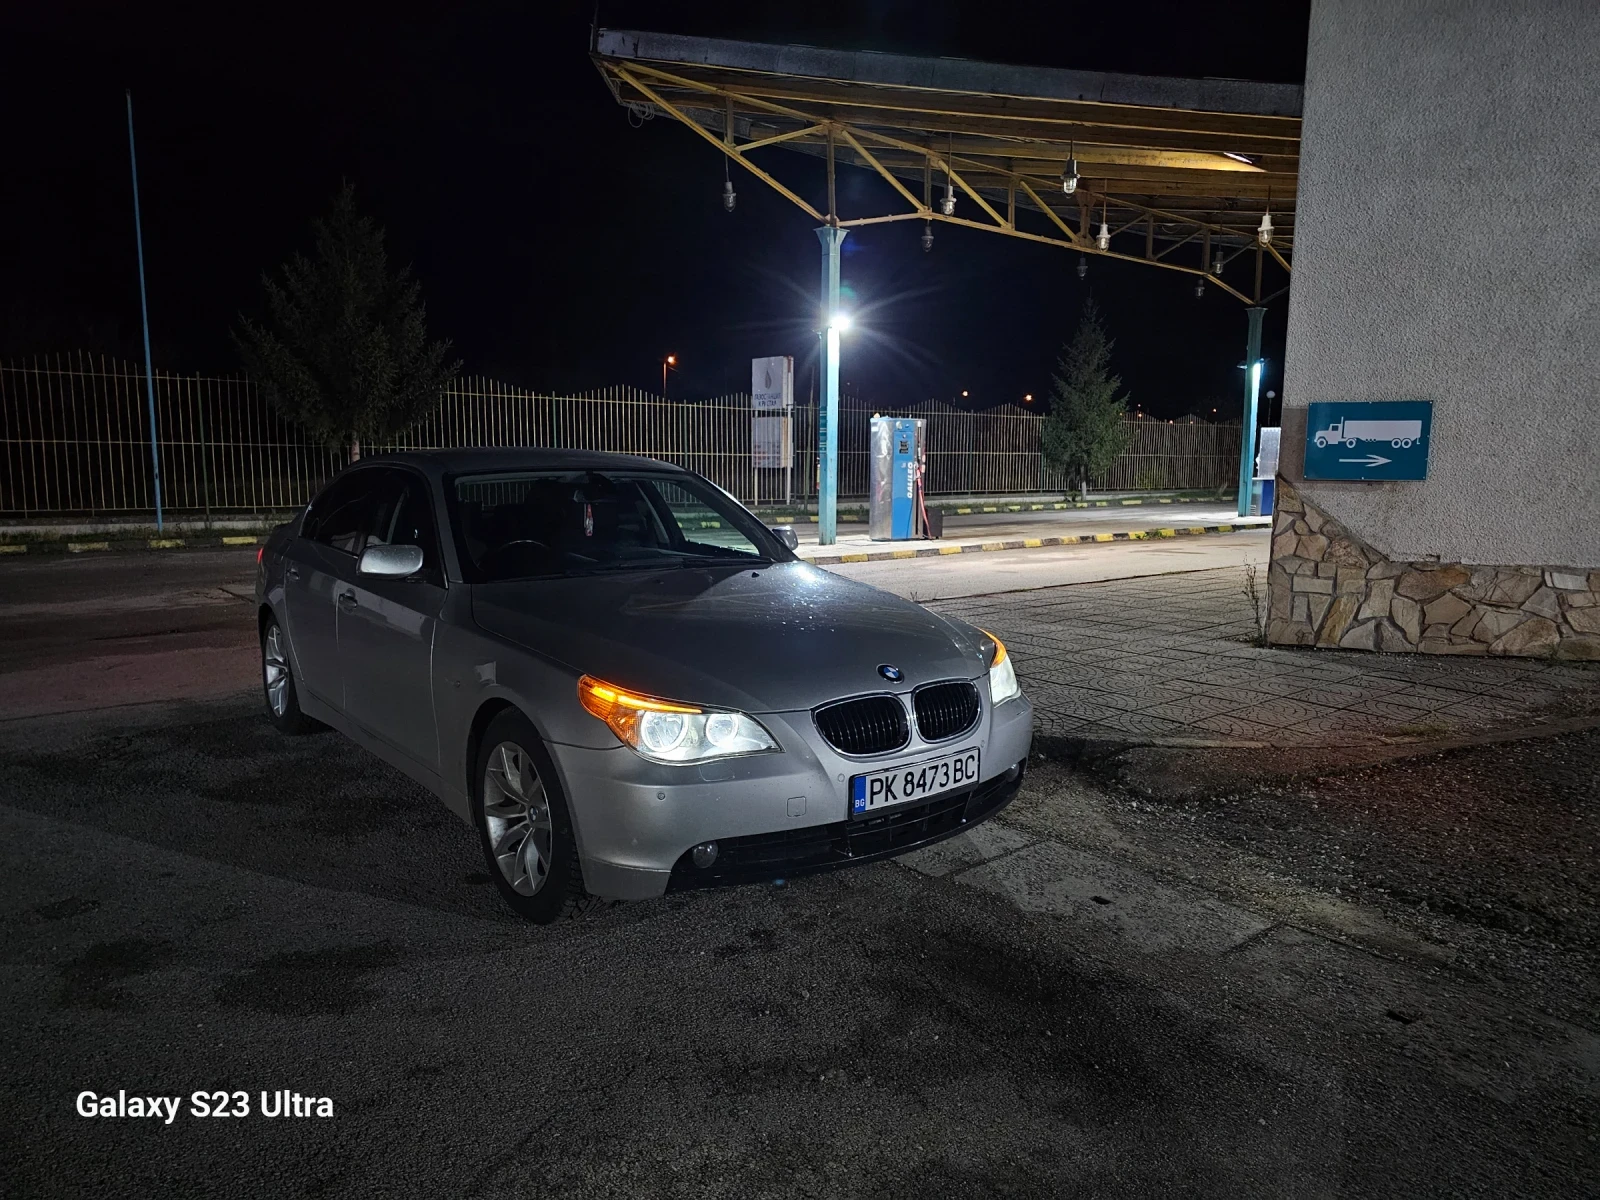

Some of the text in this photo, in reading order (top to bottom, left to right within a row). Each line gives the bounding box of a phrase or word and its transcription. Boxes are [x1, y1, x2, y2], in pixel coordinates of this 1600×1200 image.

[869, 754, 975, 806] PK 8473 BC
[855, 798, 865, 808] BG
